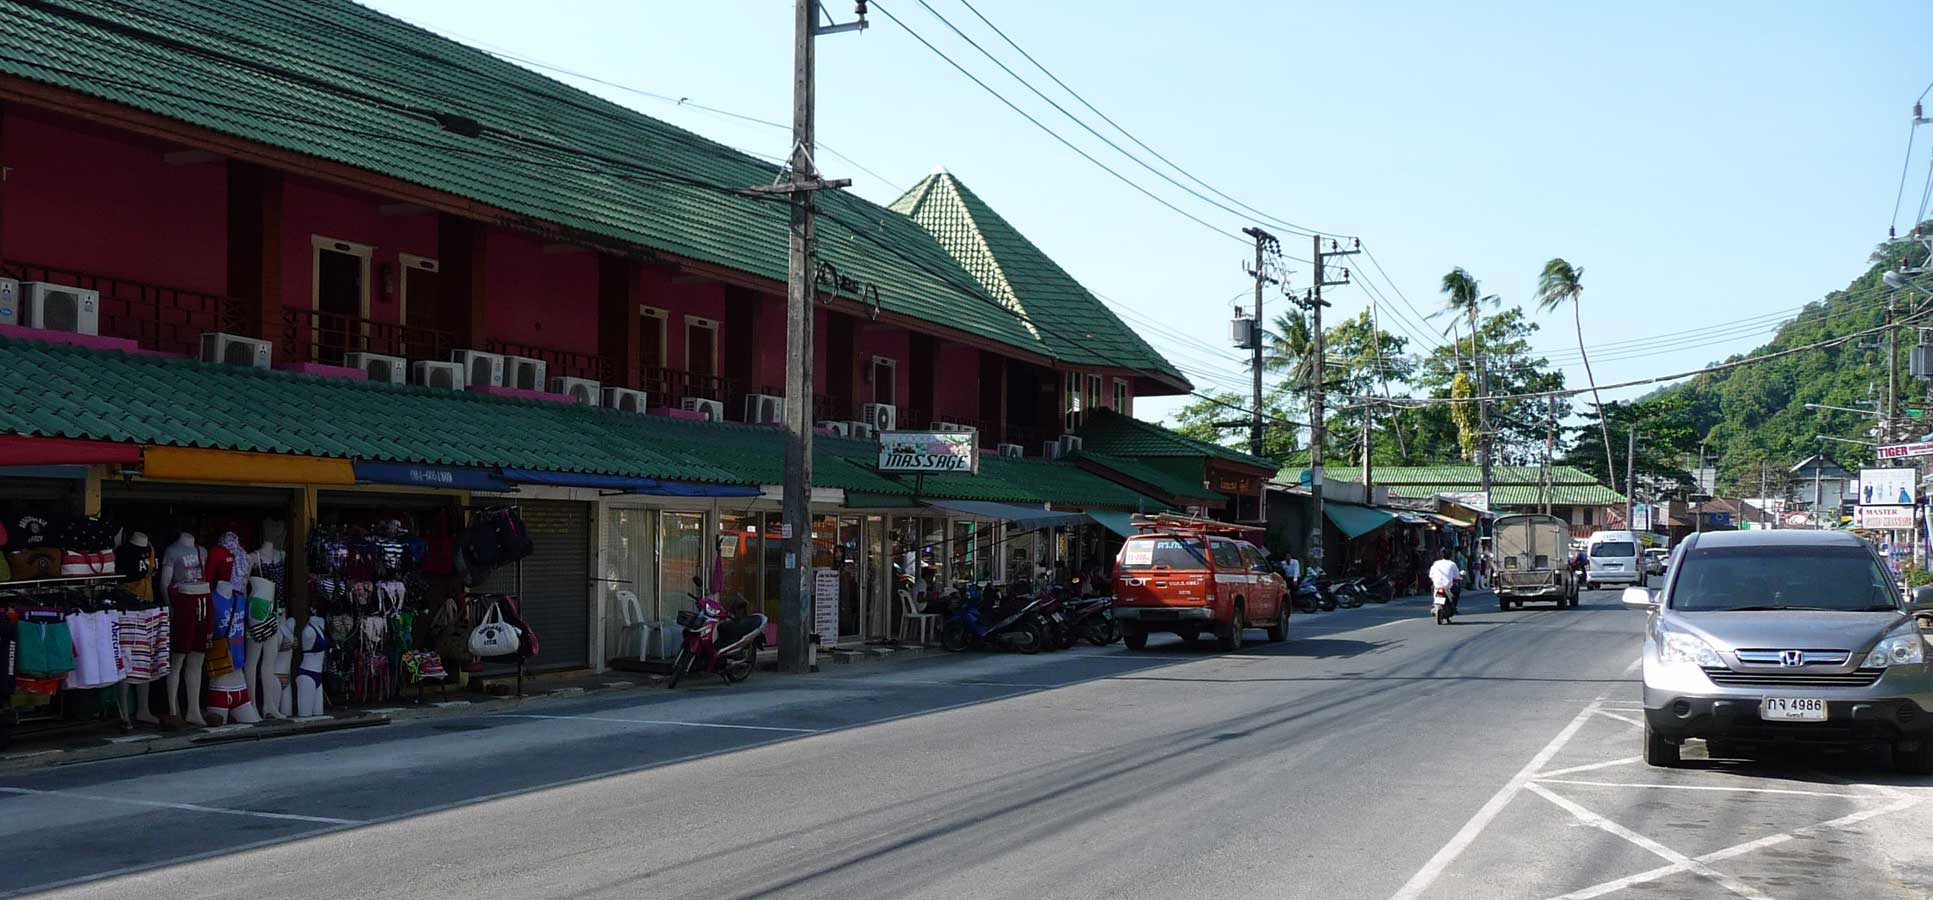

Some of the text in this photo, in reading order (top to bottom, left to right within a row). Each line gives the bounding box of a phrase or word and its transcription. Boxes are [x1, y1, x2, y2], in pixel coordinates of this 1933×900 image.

[1879, 446, 1908, 458] TIGER
[884, 454, 969, 470] MASSAGE
[1120, 577, 1153, 587] TOT
[1790, 699, 1822, 711] 4986
